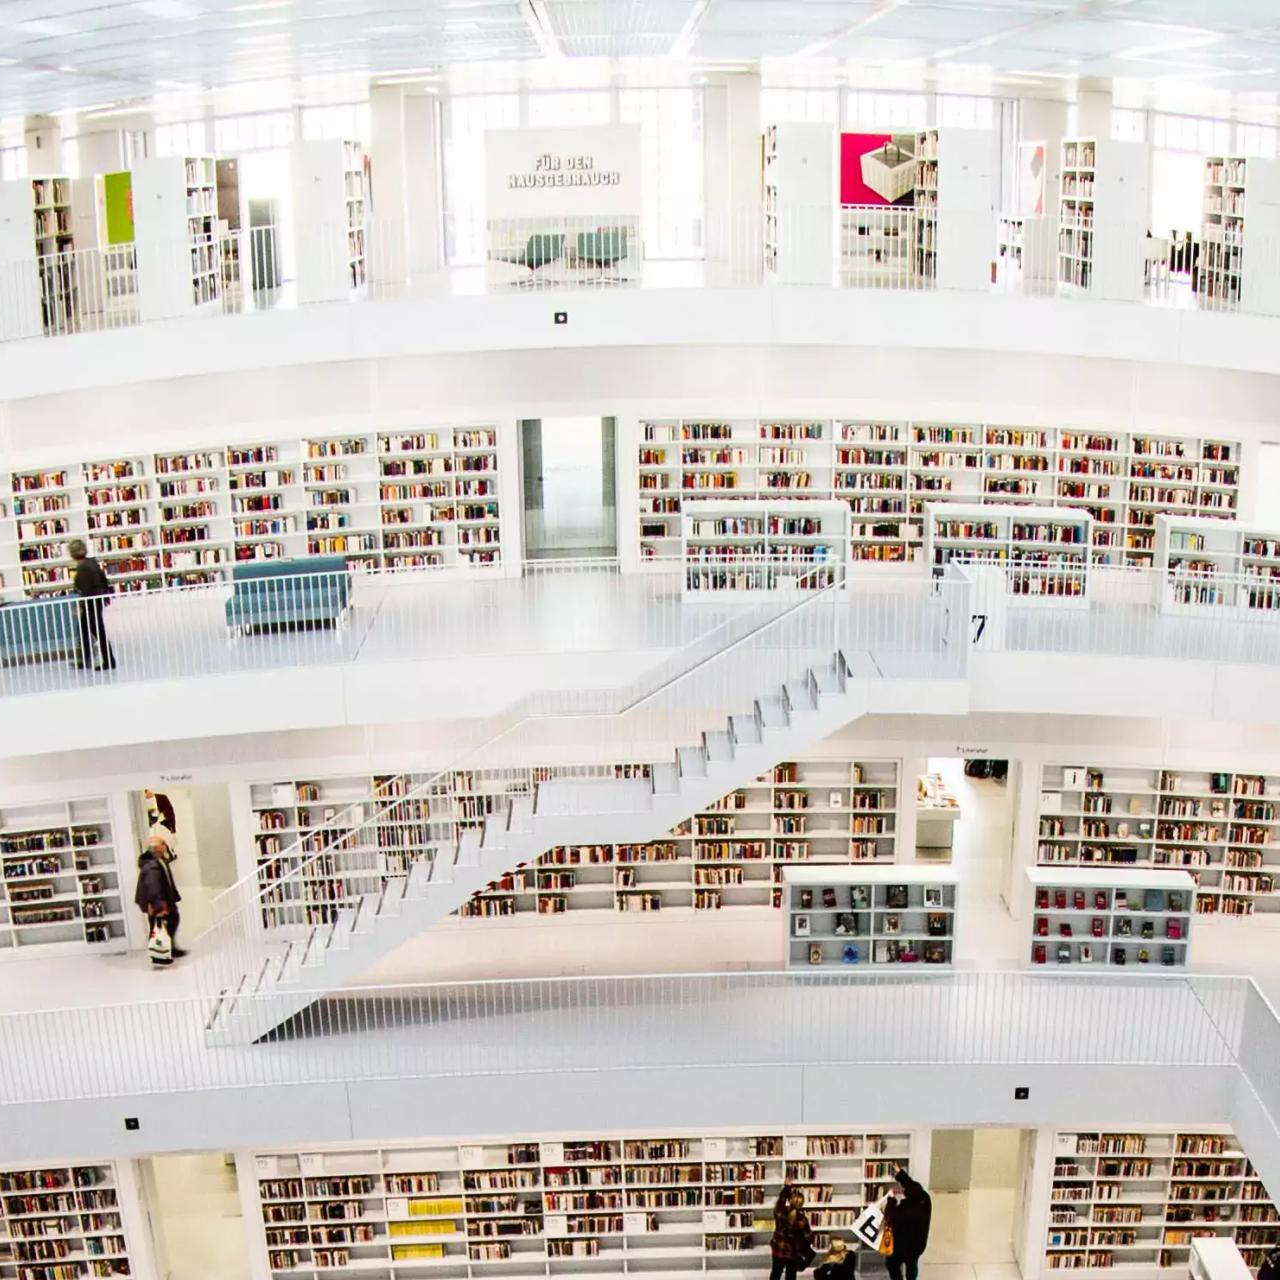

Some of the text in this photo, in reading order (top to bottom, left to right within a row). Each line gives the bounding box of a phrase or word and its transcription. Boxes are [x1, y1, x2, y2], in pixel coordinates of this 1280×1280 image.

[535, 154, 594, 171] FÜR DEN
[508, 170, 620, 190] HAUSGEBRAUCH
[971, 614, 988, 644] 7
